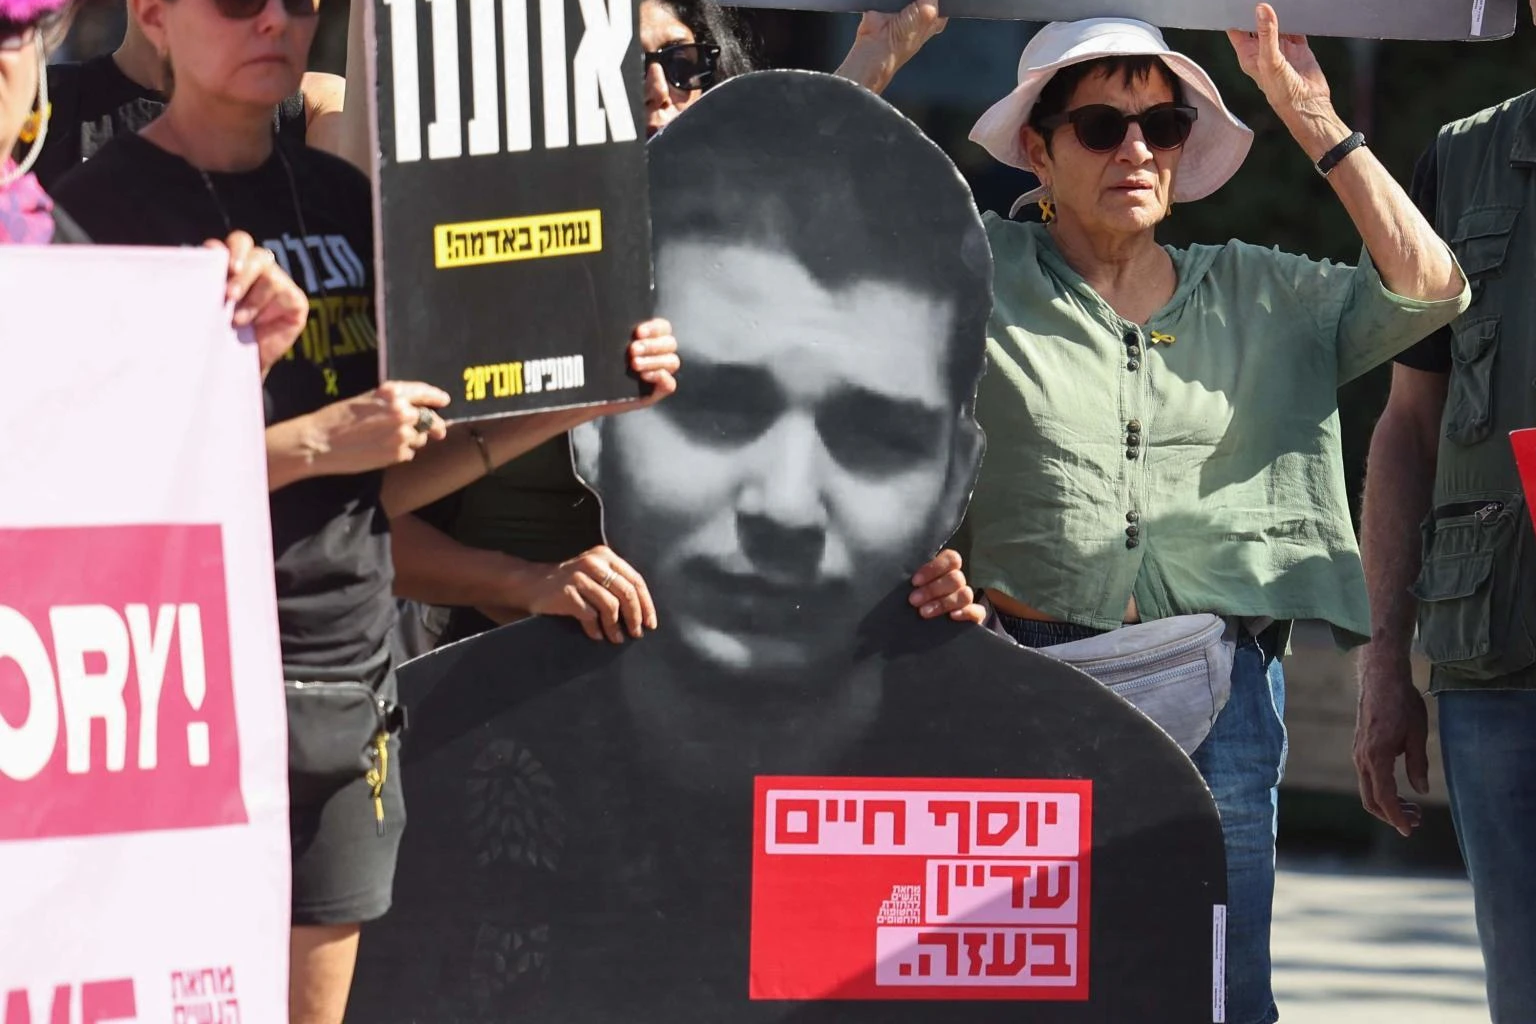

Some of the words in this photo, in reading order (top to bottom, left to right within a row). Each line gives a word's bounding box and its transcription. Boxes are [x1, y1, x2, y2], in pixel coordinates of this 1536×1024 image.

[446, 227, 532, 259] באדמה!
[539, 220, 590, 255] עמוק
[776, 799, 906, 846] חיים
[927, 801, 1058, 854] יוסף
[936, 865, 1070, 916] עדיין
[899, 933, 1071, 977] בעזה.
[170, 966, 235, 999] מחאת
